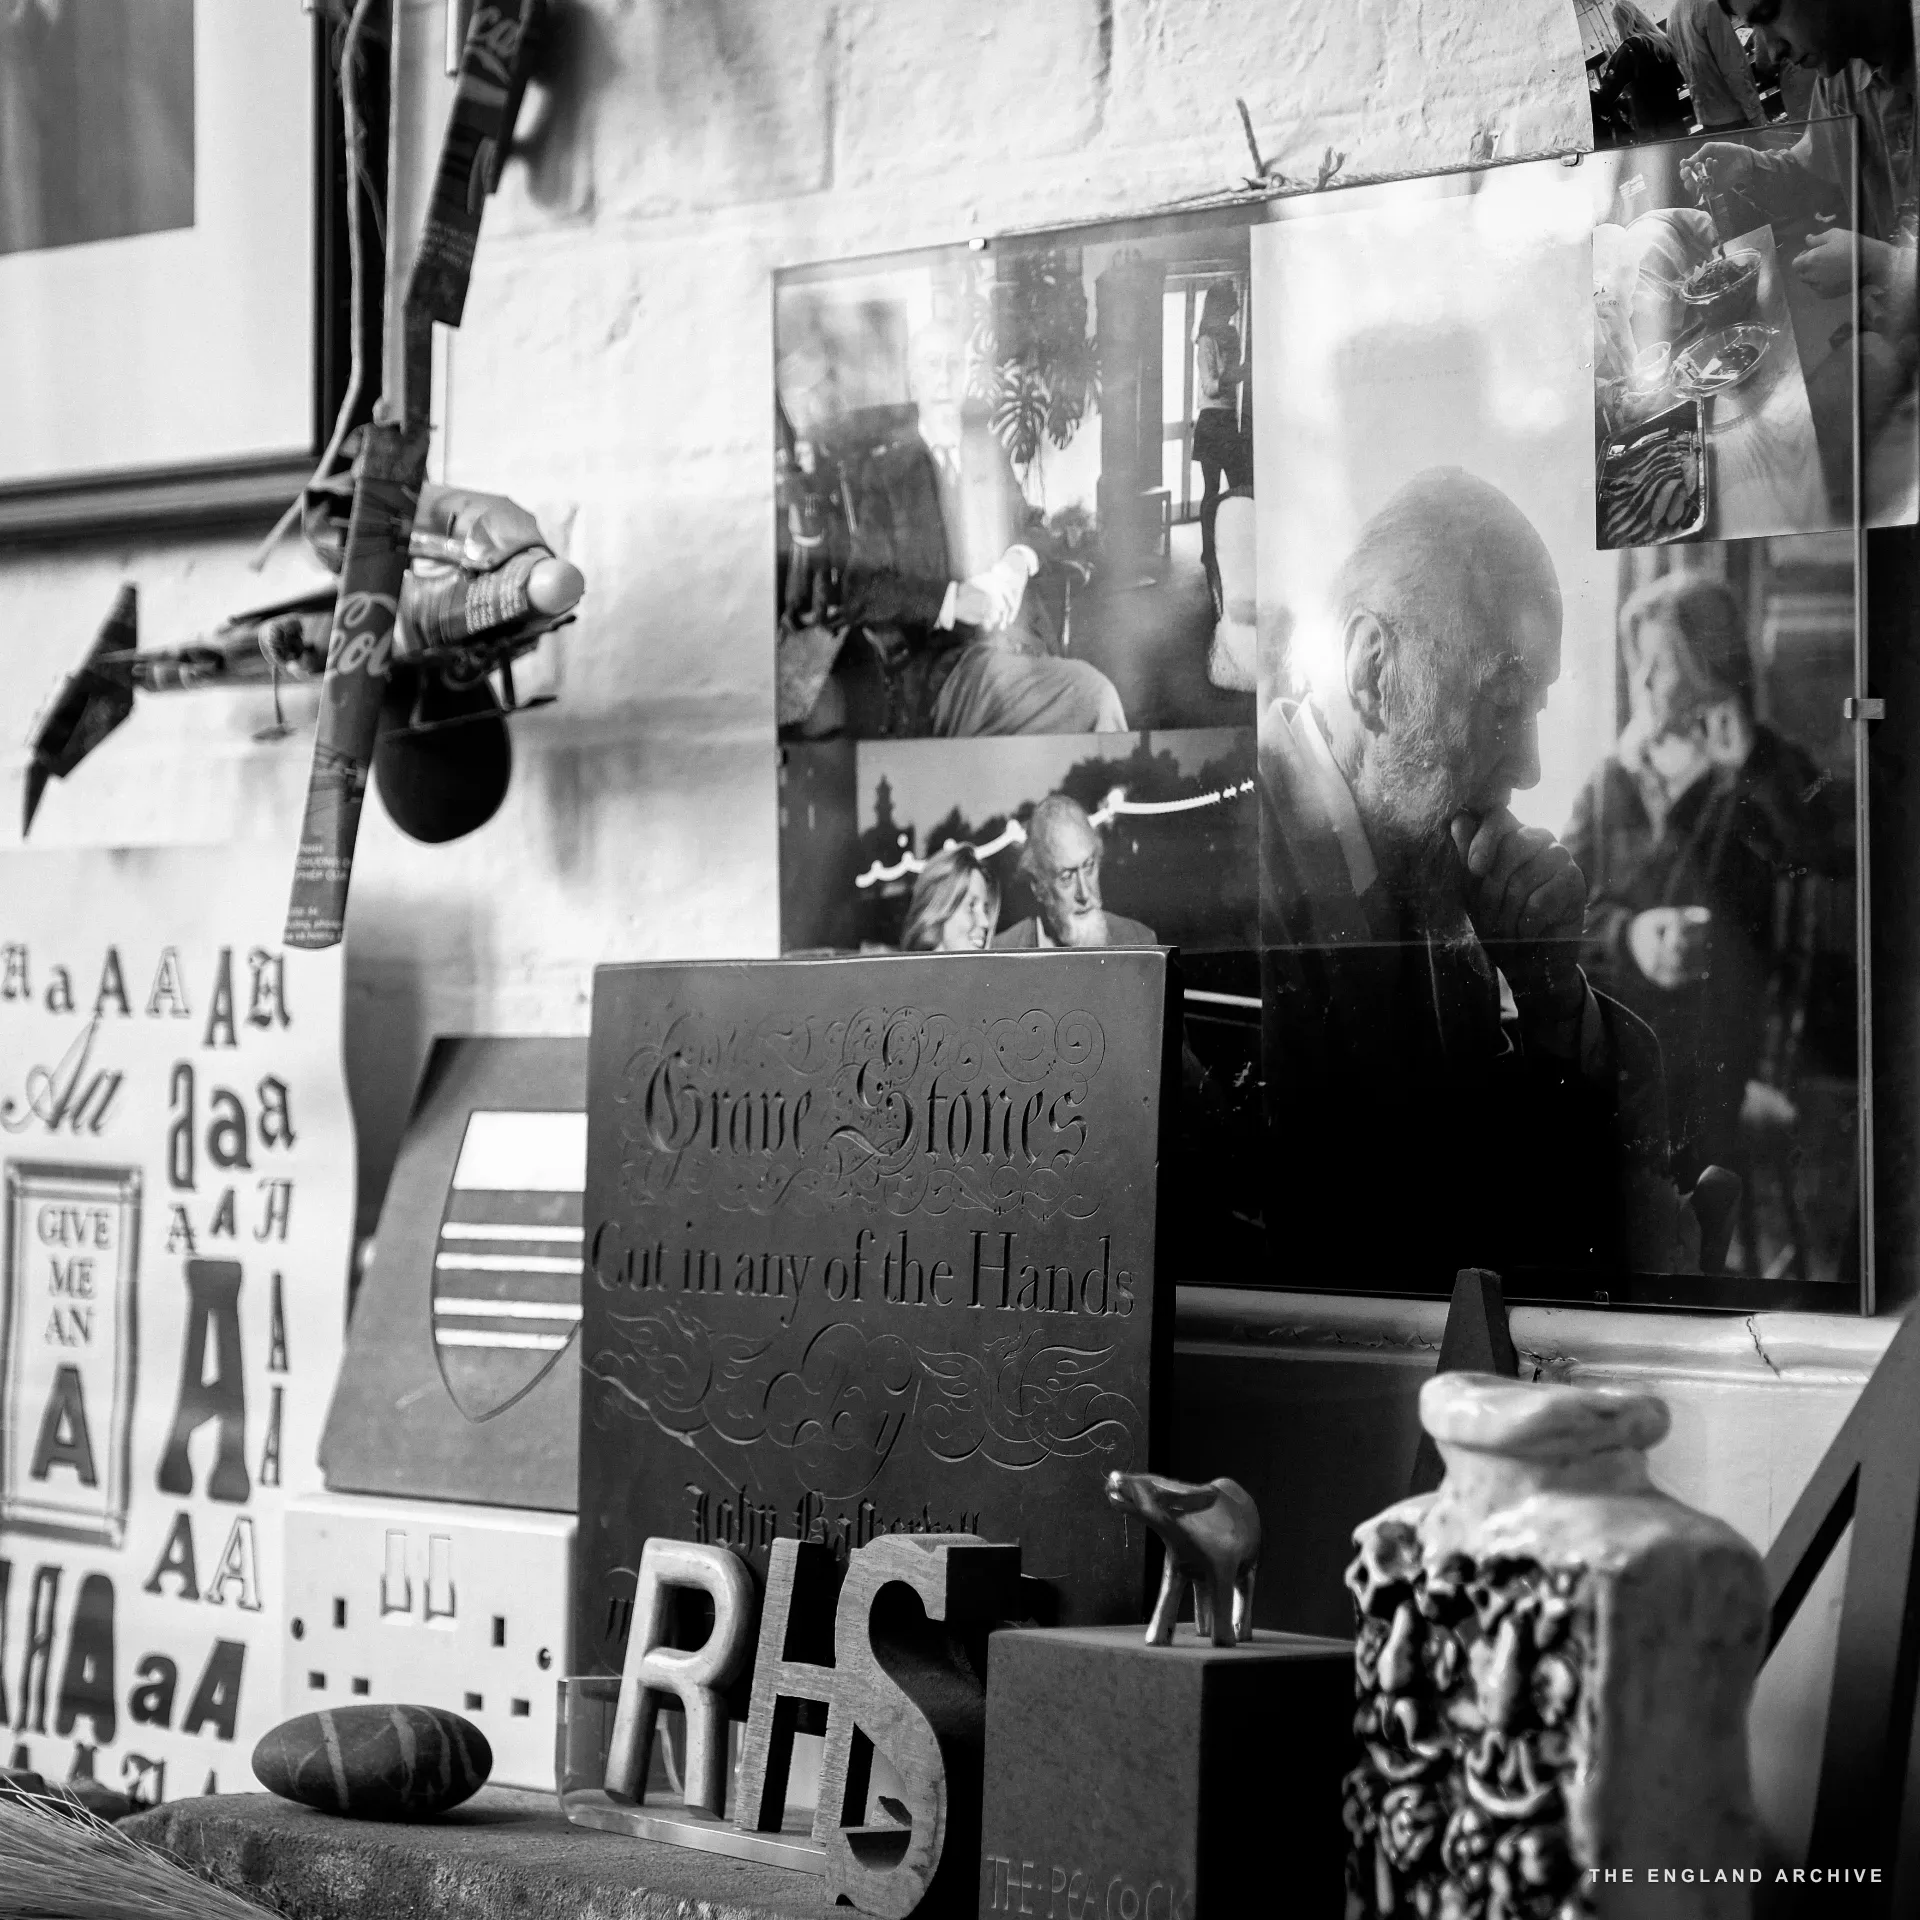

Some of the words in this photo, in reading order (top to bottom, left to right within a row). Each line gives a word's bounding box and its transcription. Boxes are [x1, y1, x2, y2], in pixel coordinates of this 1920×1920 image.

[37, 1204, 110, 1249] GIVE
[51, 1255, 96, 1299] ME
[591, 1219, 668, 1293] Cut
[682, 1221, 724, 1297] in
[734, 1251, 813, 1328] any
[824, 1229, 876, 1303] of
[882, 1229, 954, 1308] the
[967, 1229, 1135, 1318] Hands
[47, 1304, 93, 1344] AN
[29, 1364, 98, 1488] A
[984, 1857, 1035, 1914] THE
